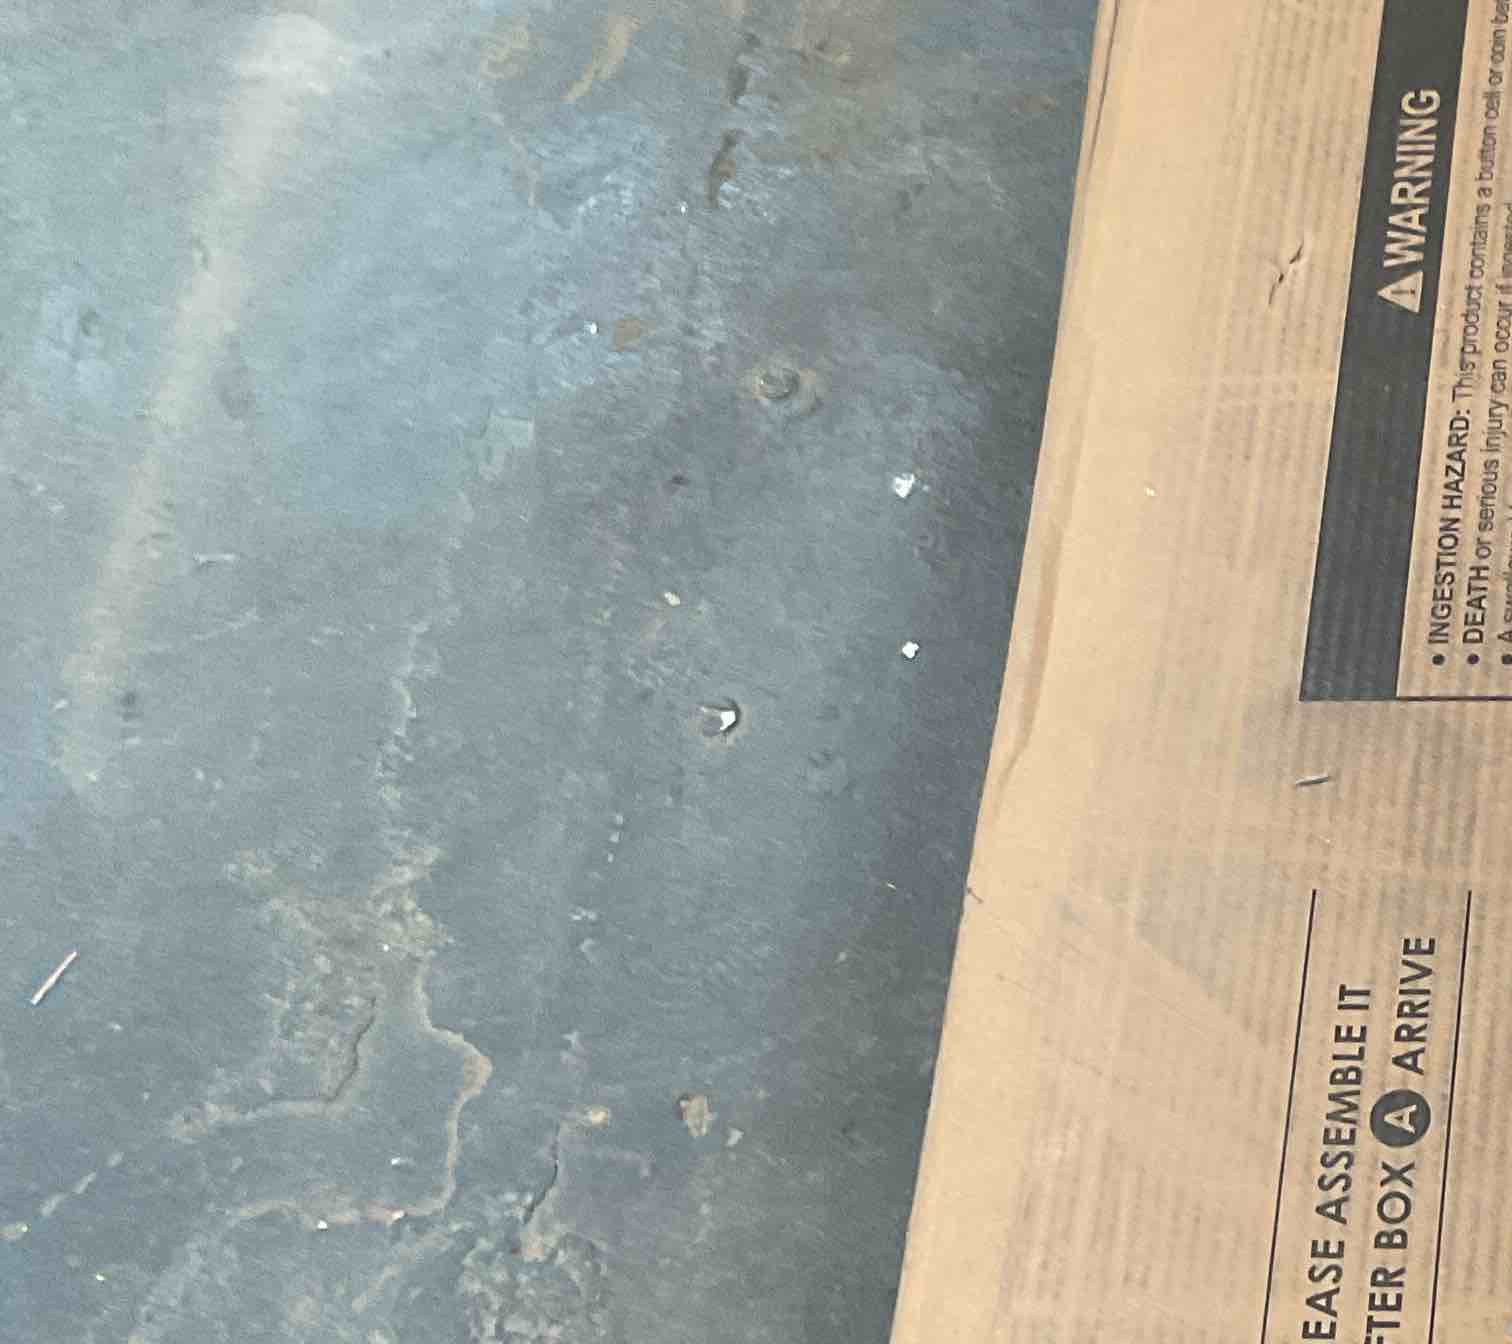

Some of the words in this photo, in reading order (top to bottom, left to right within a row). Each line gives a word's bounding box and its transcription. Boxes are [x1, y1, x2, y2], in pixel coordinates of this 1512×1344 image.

[1489, 29, 1507, 63] coin
[1487, 68, 1504, 86] or
[1481, 91, 1501, 121] cell
[1382, 88, 1441, 268] WARNING
[1475, 126, 1498, 181] button
[1476, 187, 1493, 198] a
[1467, 203, 1492, 279] contains
[1496, 284, 1512, 296] if
[1459, 284, 1481, 355] product
[1493, 300, 1512, 353] occur
[1451, 361, 1477, 402] This
[1489, 359, 1507, 394] can
[1480, 400, 1509, 452] injury
[1441, 408, 1471, 510] HAZARD:
[1475, 459, 1499, 532] serious
[1475, 537, 1492, 560] or
[1427, 517, 1461, 645] INGESTION
[1462, 565, 1489, 645] DEATH
[1337, 983, 1371, 1011] IT
[1391, 935, 1436, 1076] ARRIVE
[1313, 1023, 1368, 1225] ASSEMBLE
[1381, 1103, 1417, 1135] A
[1372, 1160, 1415, 1250] BOX
